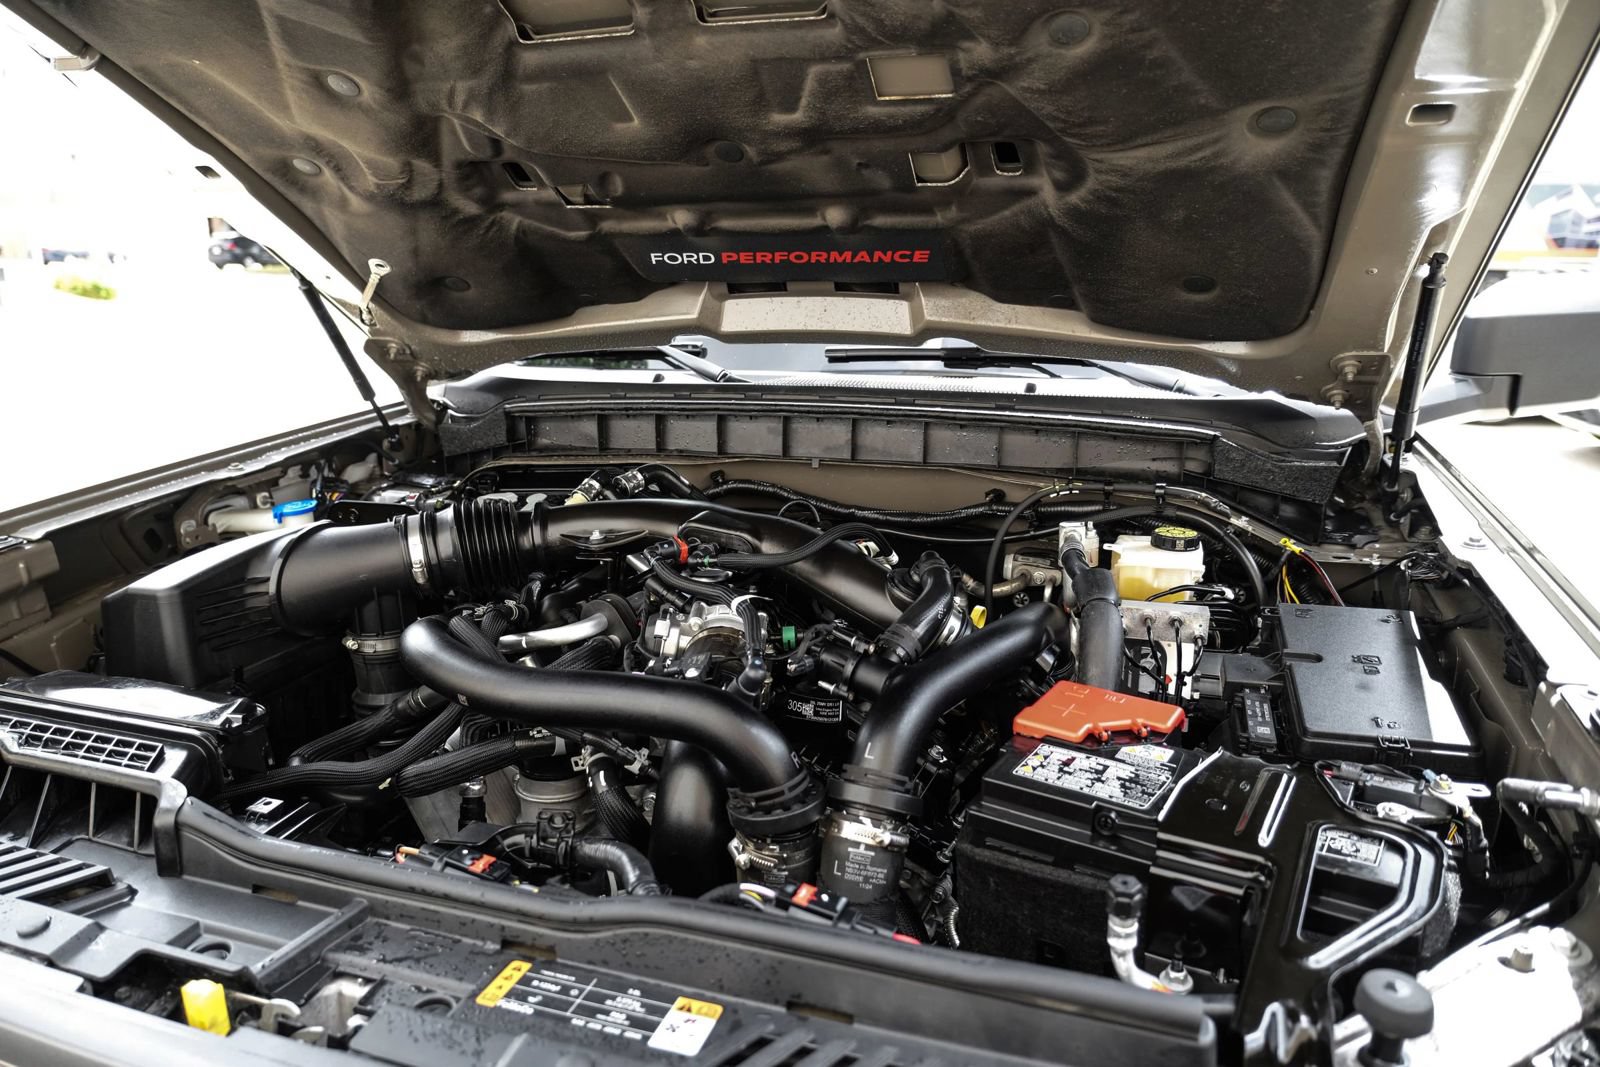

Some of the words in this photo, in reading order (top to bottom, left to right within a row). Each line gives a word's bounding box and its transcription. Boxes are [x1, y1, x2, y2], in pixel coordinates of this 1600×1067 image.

[650, 252, 715, 265] FORD
[721, 249, 931, 264] PERFORMANCE
[787, 699, 803, 712] 305
[864, 742, 875, 759] L
[790, 751, 801, 769] R
[833, 860, 842, 876] L
